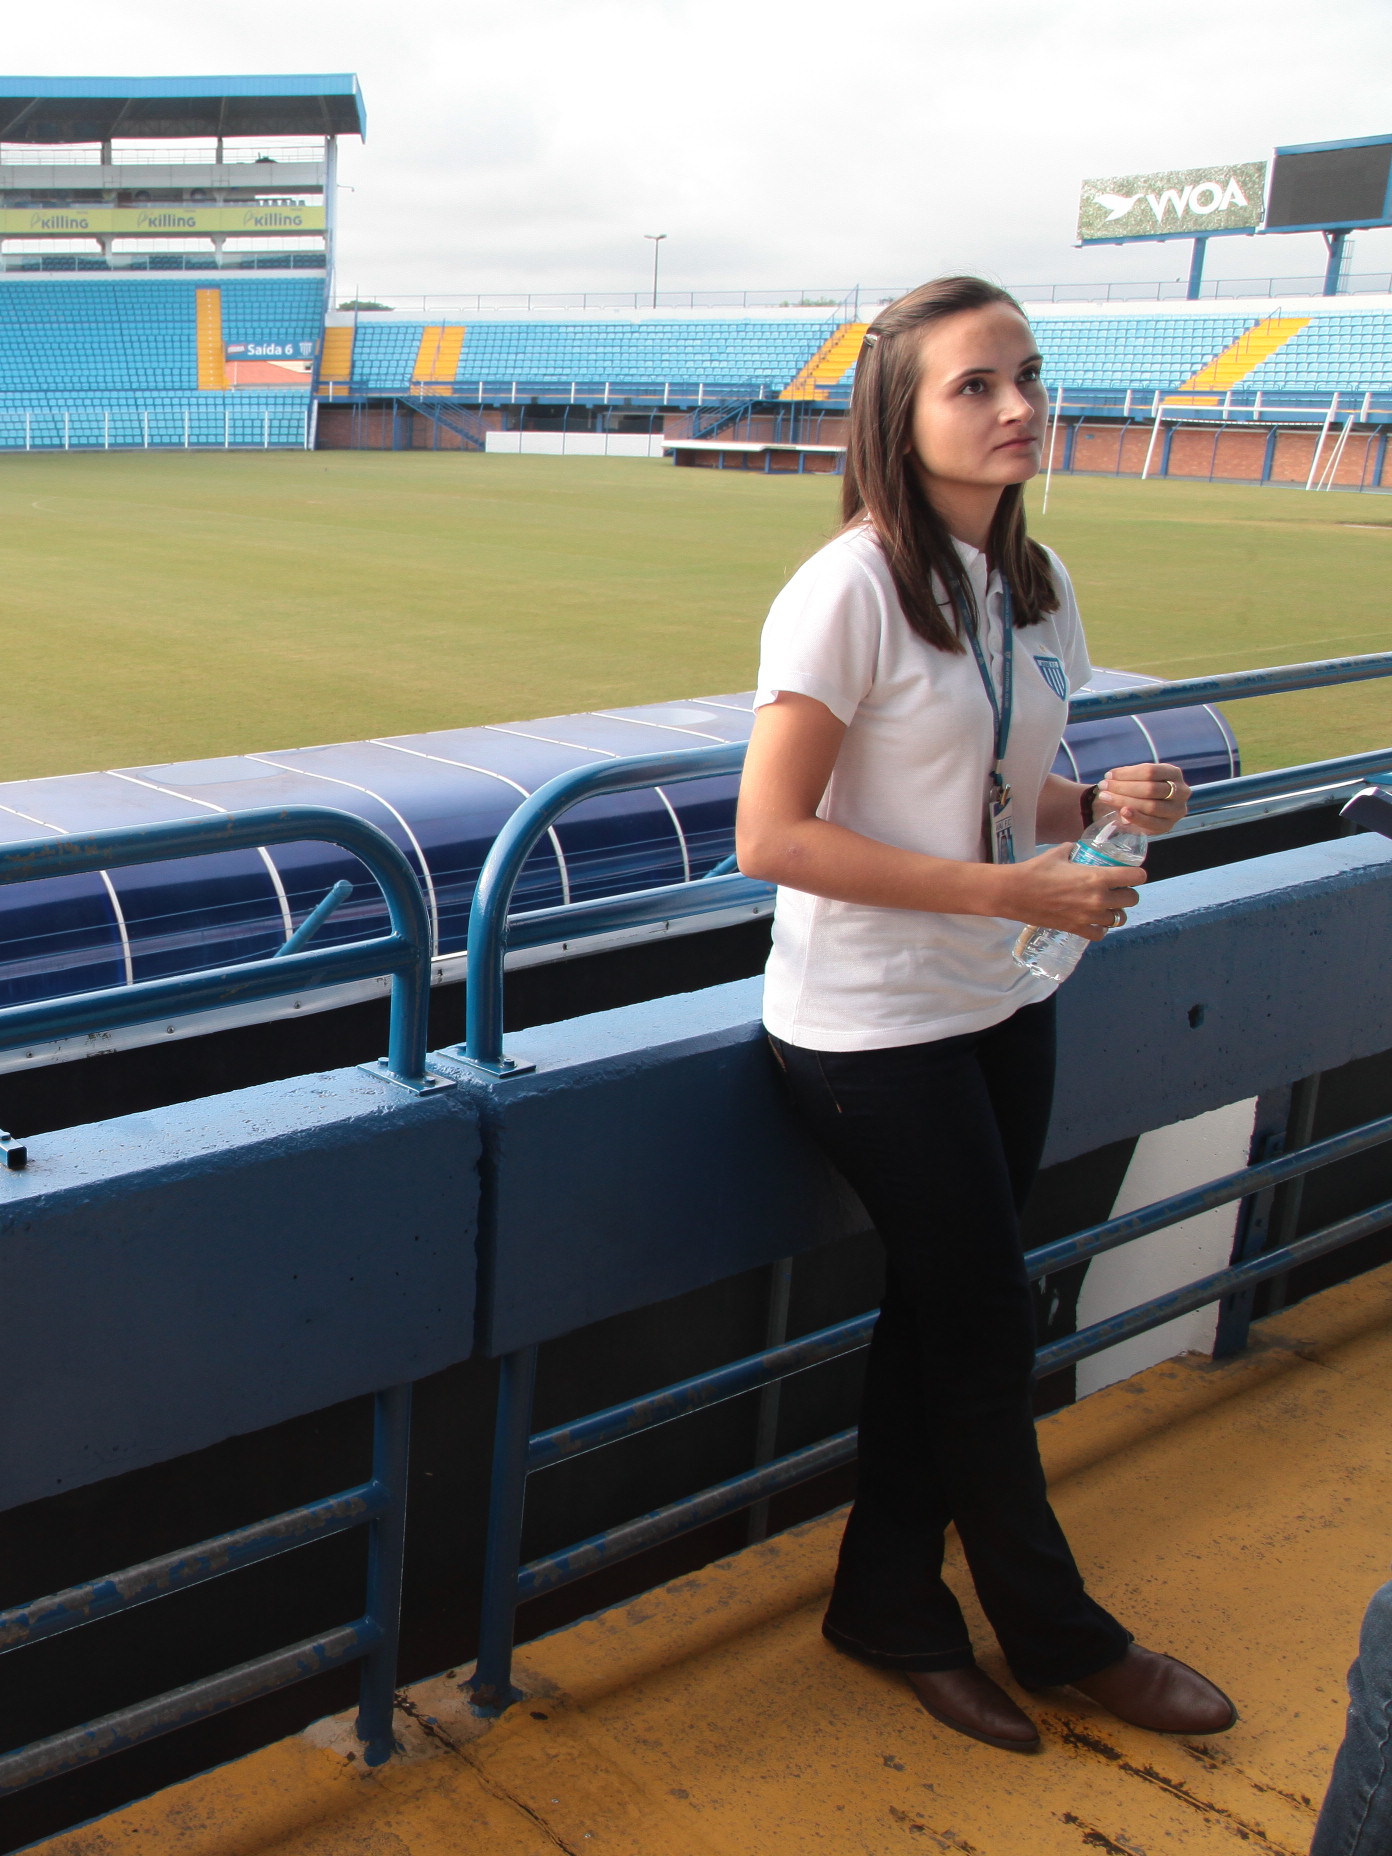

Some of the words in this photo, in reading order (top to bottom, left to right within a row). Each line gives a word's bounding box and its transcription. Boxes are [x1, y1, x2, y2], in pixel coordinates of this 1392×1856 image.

[1145, 176, 1249, 223] WOA
[248, 343, 282, 356] Saída
[284, 344, 293, 356] 6
